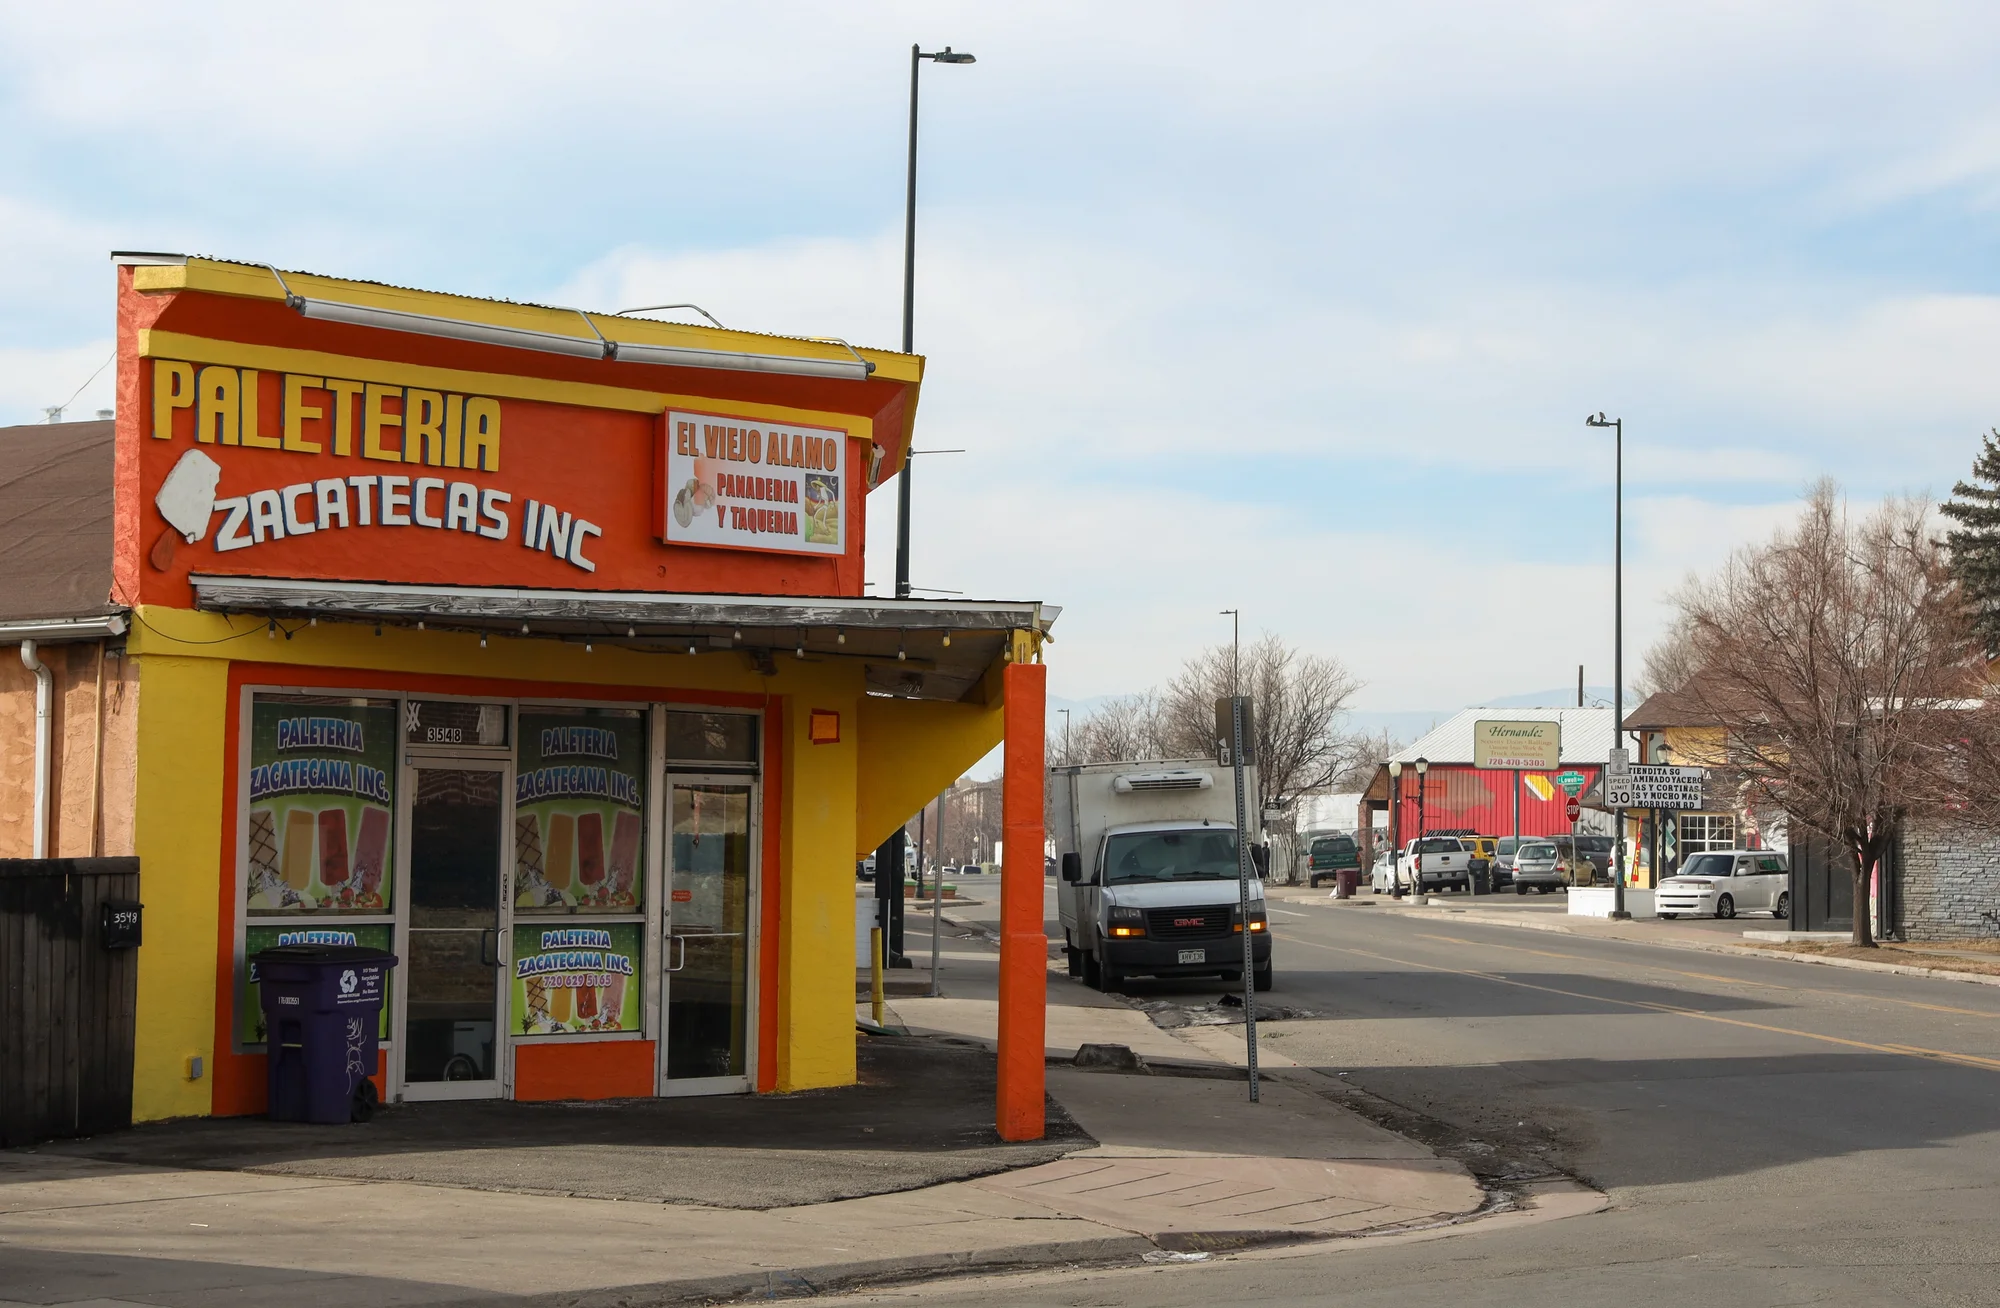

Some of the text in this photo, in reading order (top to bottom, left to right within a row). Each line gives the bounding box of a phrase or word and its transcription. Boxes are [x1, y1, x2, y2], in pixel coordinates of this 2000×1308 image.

[152, 359, 501, 471] PALETERIA
[677, 421, 837, 472] EL VIEJO ALAMO
[717, 472, 798, 504] PANADERIA
[213, 475, 602, 572] ZACATECAS INC
[717, 505, 798, 535] Y TAQUERIA
[278, 717, 364, 752] PALETERIA
[428, 728, 461, 742] 3548
[1489, 724, 1543, 738] Hernandez
[542, 726, 618, 760] PALETERIA
[1488, 758, 1545, 767] 720-470-5303
[250, 758, 390, 802] ZACATECANA INC.
[516, 765, 641, 806] ZACATECANA INC.
[1633, 775, 1670, 783] AMINADO
[1656, 784, 1699, 792] CORTINAS
[1610, 792, 1630, 803] 30
[1650, 792, 1680, 800] MUCHO
[1567, 805, 1579, 815] STOP
[1638, 800, 1681, 808] MORRISON
[1683, 801, 1695, 809] RD
[113, 911, 138, 924] 3548
[1173, 917, 1205, 927] GMC
[541, 929, 612, 949] PALETERIA
[517, 951, 634, 977] ZACATECANA INC.
[543, 974, 612, 988] 720 629 5165
